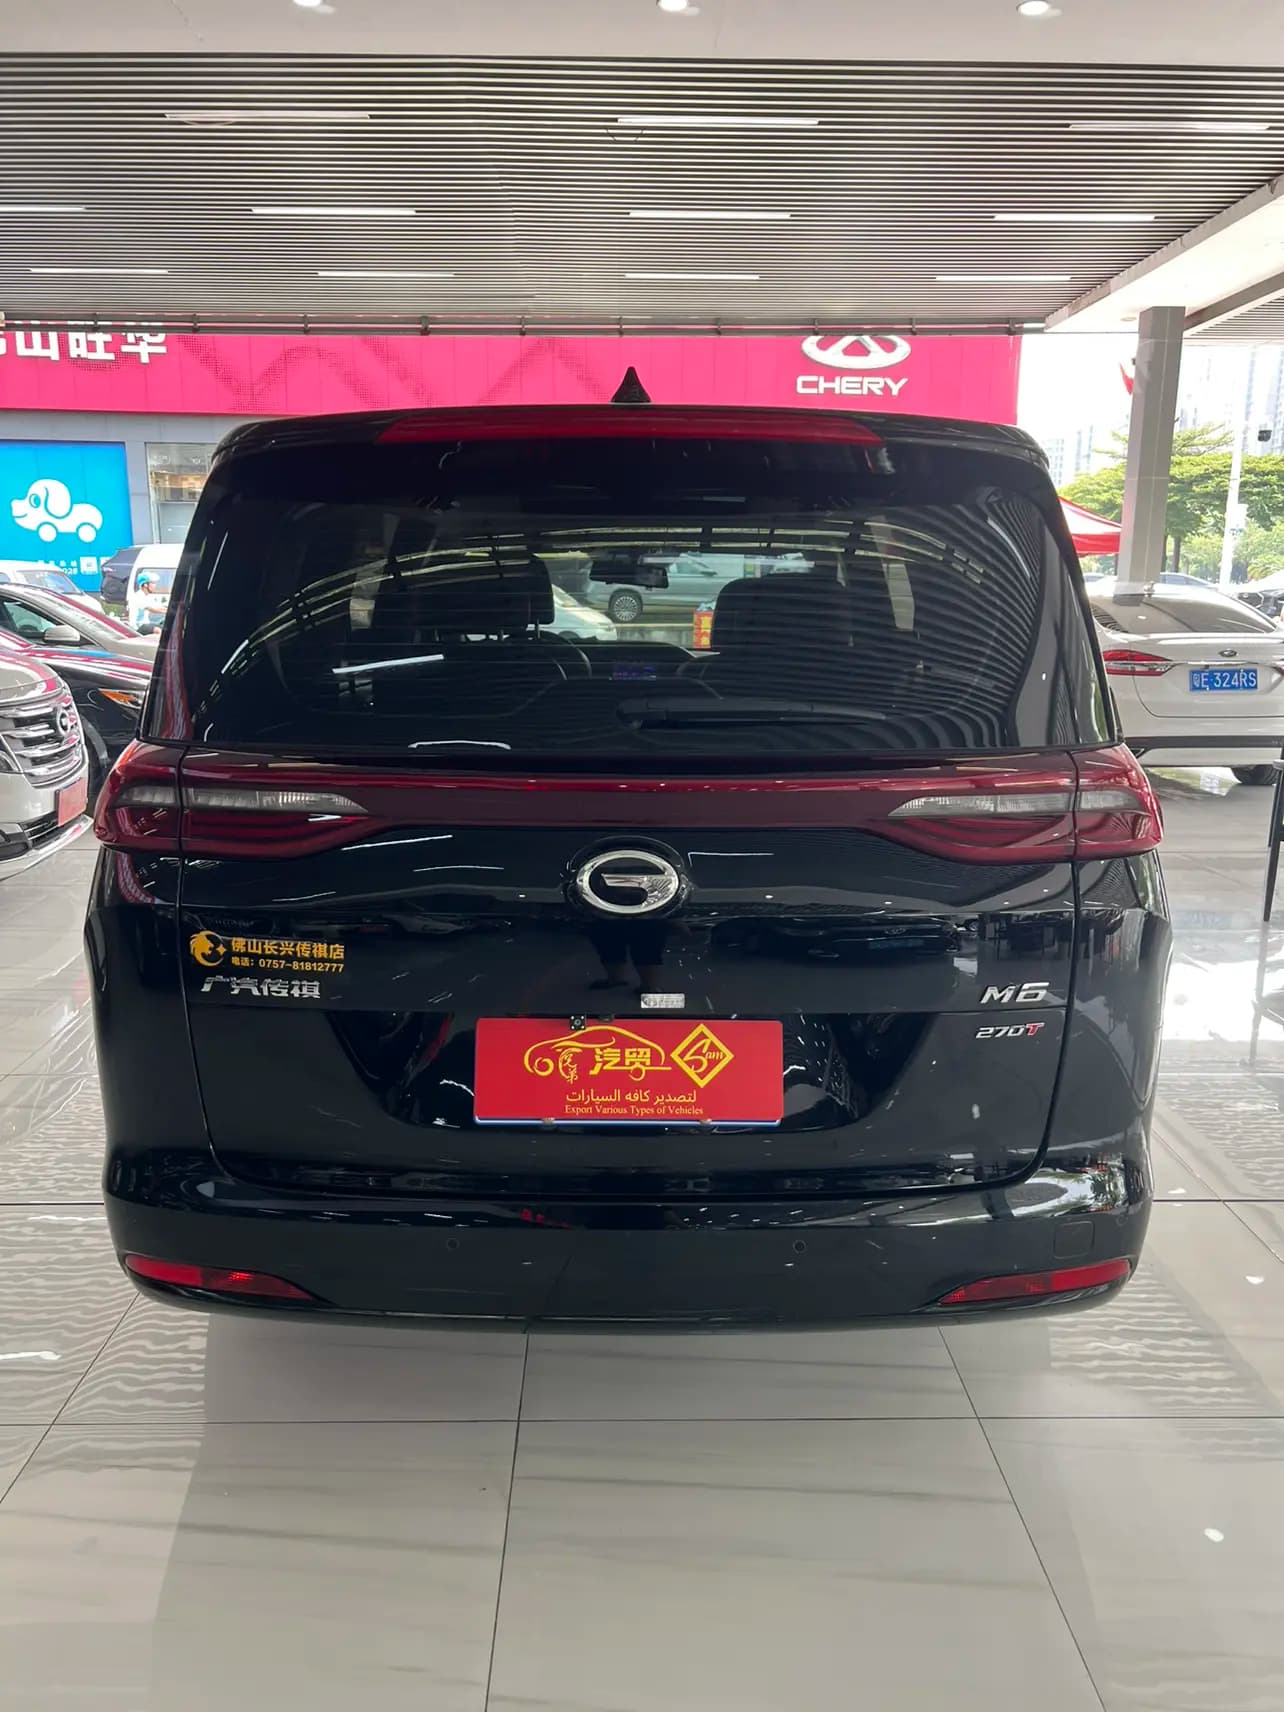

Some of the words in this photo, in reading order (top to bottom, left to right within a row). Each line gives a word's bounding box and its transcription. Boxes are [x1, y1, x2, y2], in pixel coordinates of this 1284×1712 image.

[796, 375, 909, 396] CHERY
[231, 937, 345, 960] 佛山长兴传祺店
[200, 975, 321, 999] 广汽传祺
[980, 982, 1050, 1004] M6
[976, 1022, 1045, 1039] 270T
[566, 1088, 620, 1105] السيارات
[653, 1088, 697, 1106] لتصدير
[565, 1105, 593, 1116] Export
[595, 1105, 628, 1115] Various
[630, 1105, 655, 1117] Types
[656, 1105, 666, 1115] of
[668, 1105, 704, 1116] Vehicles
